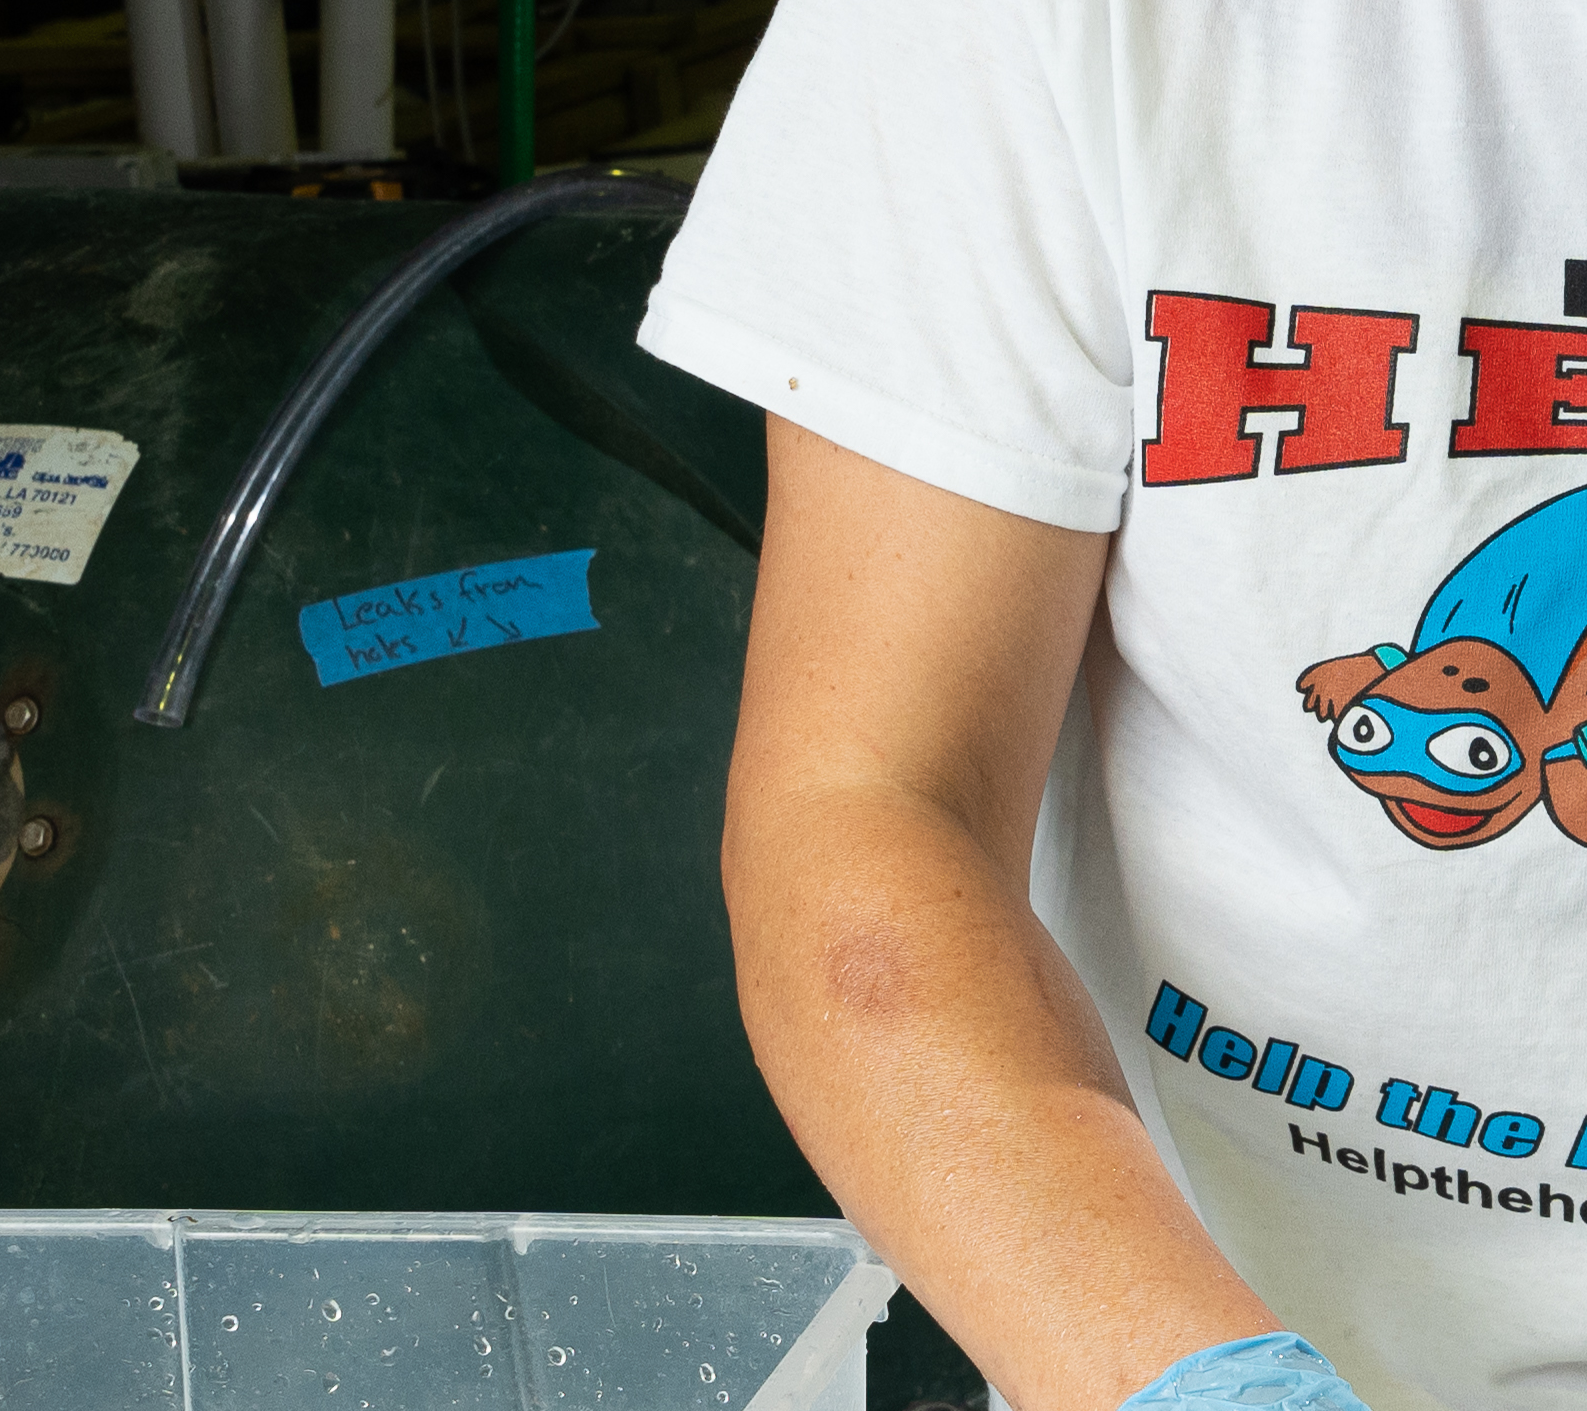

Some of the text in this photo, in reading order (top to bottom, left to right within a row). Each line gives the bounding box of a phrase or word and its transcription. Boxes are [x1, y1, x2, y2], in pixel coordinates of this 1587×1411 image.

[5, 487, 27, 501] LA
[31, 489, 78, 505] 70121
[1145, 979, 1356, 1113] Help
[1376, 1076, 1545, 1160] the
